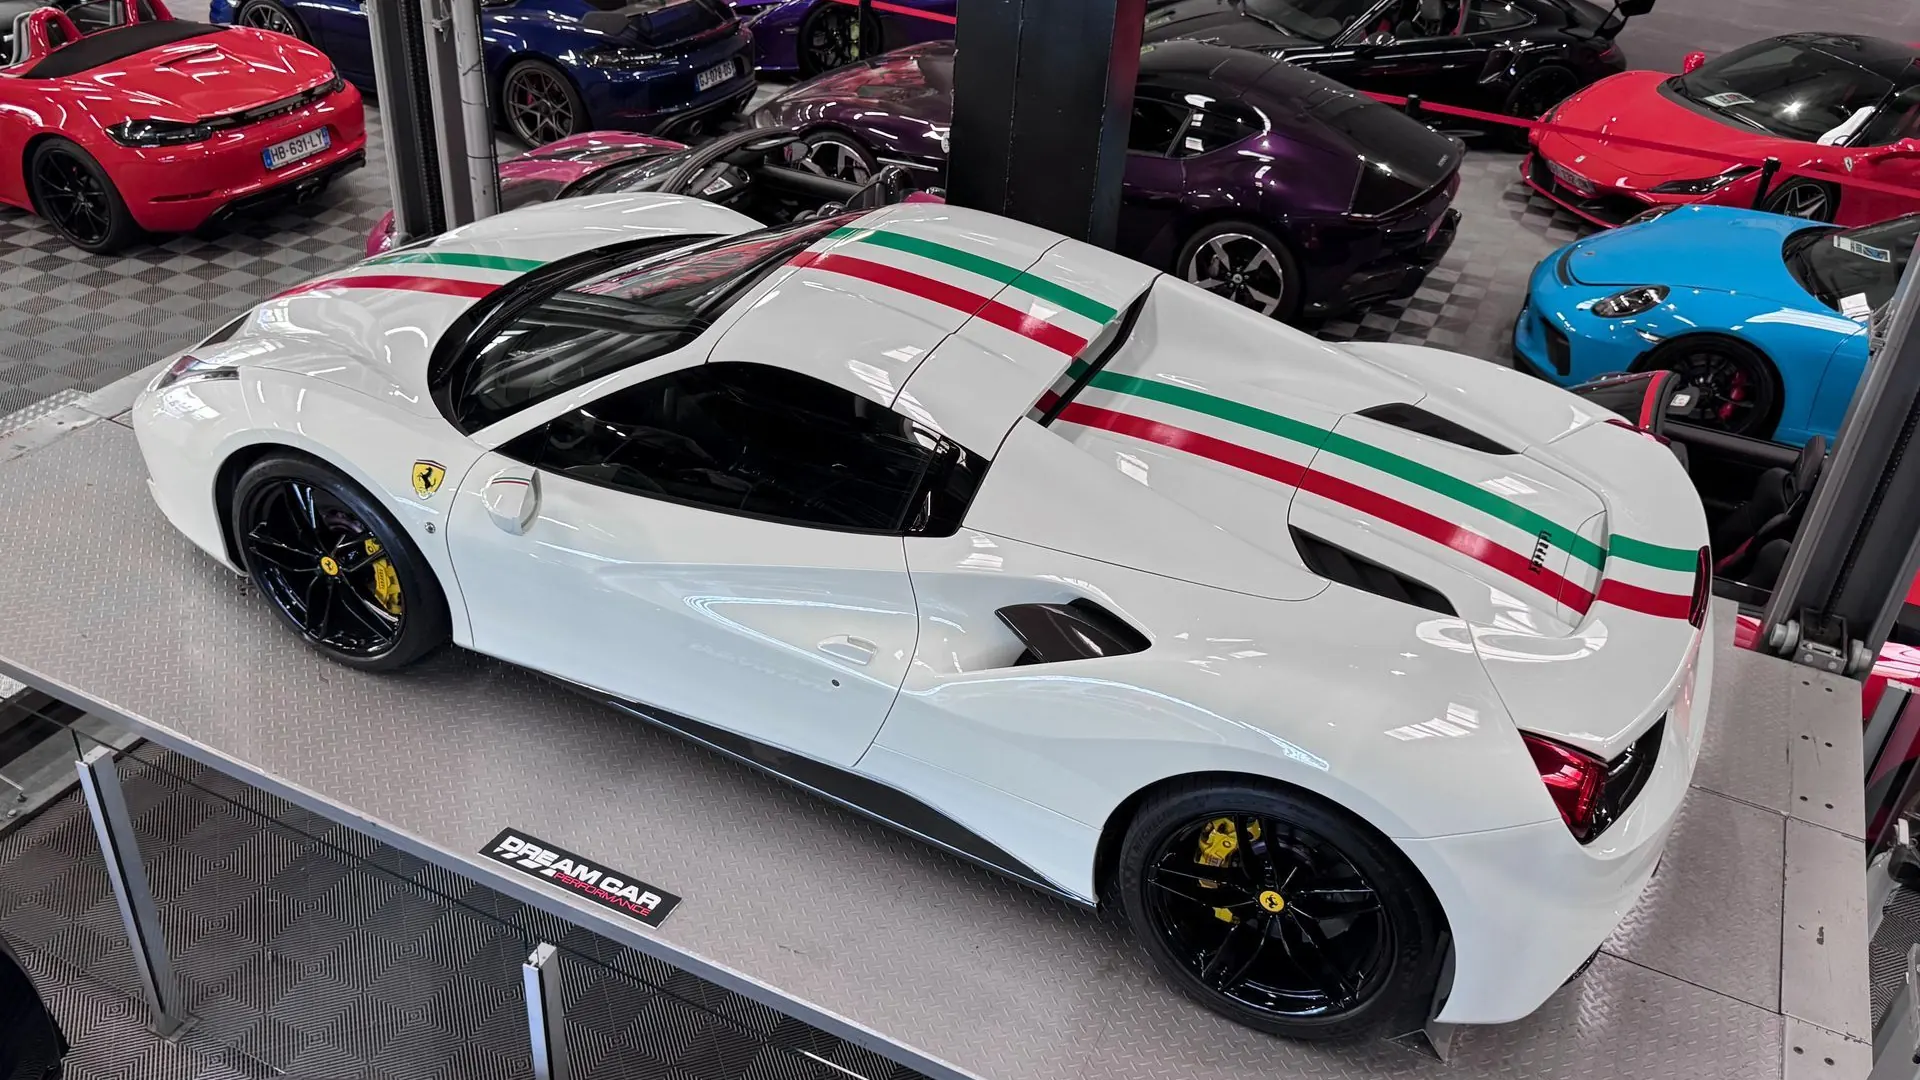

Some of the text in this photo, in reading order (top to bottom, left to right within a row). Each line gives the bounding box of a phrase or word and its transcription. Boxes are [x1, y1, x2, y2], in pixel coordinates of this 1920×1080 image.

[270, 131, 323, 162] HB-631-LY
[499, 835, 662, 911] DREAM CAR
[553, 872, 651, 917] PERFORMANCE
